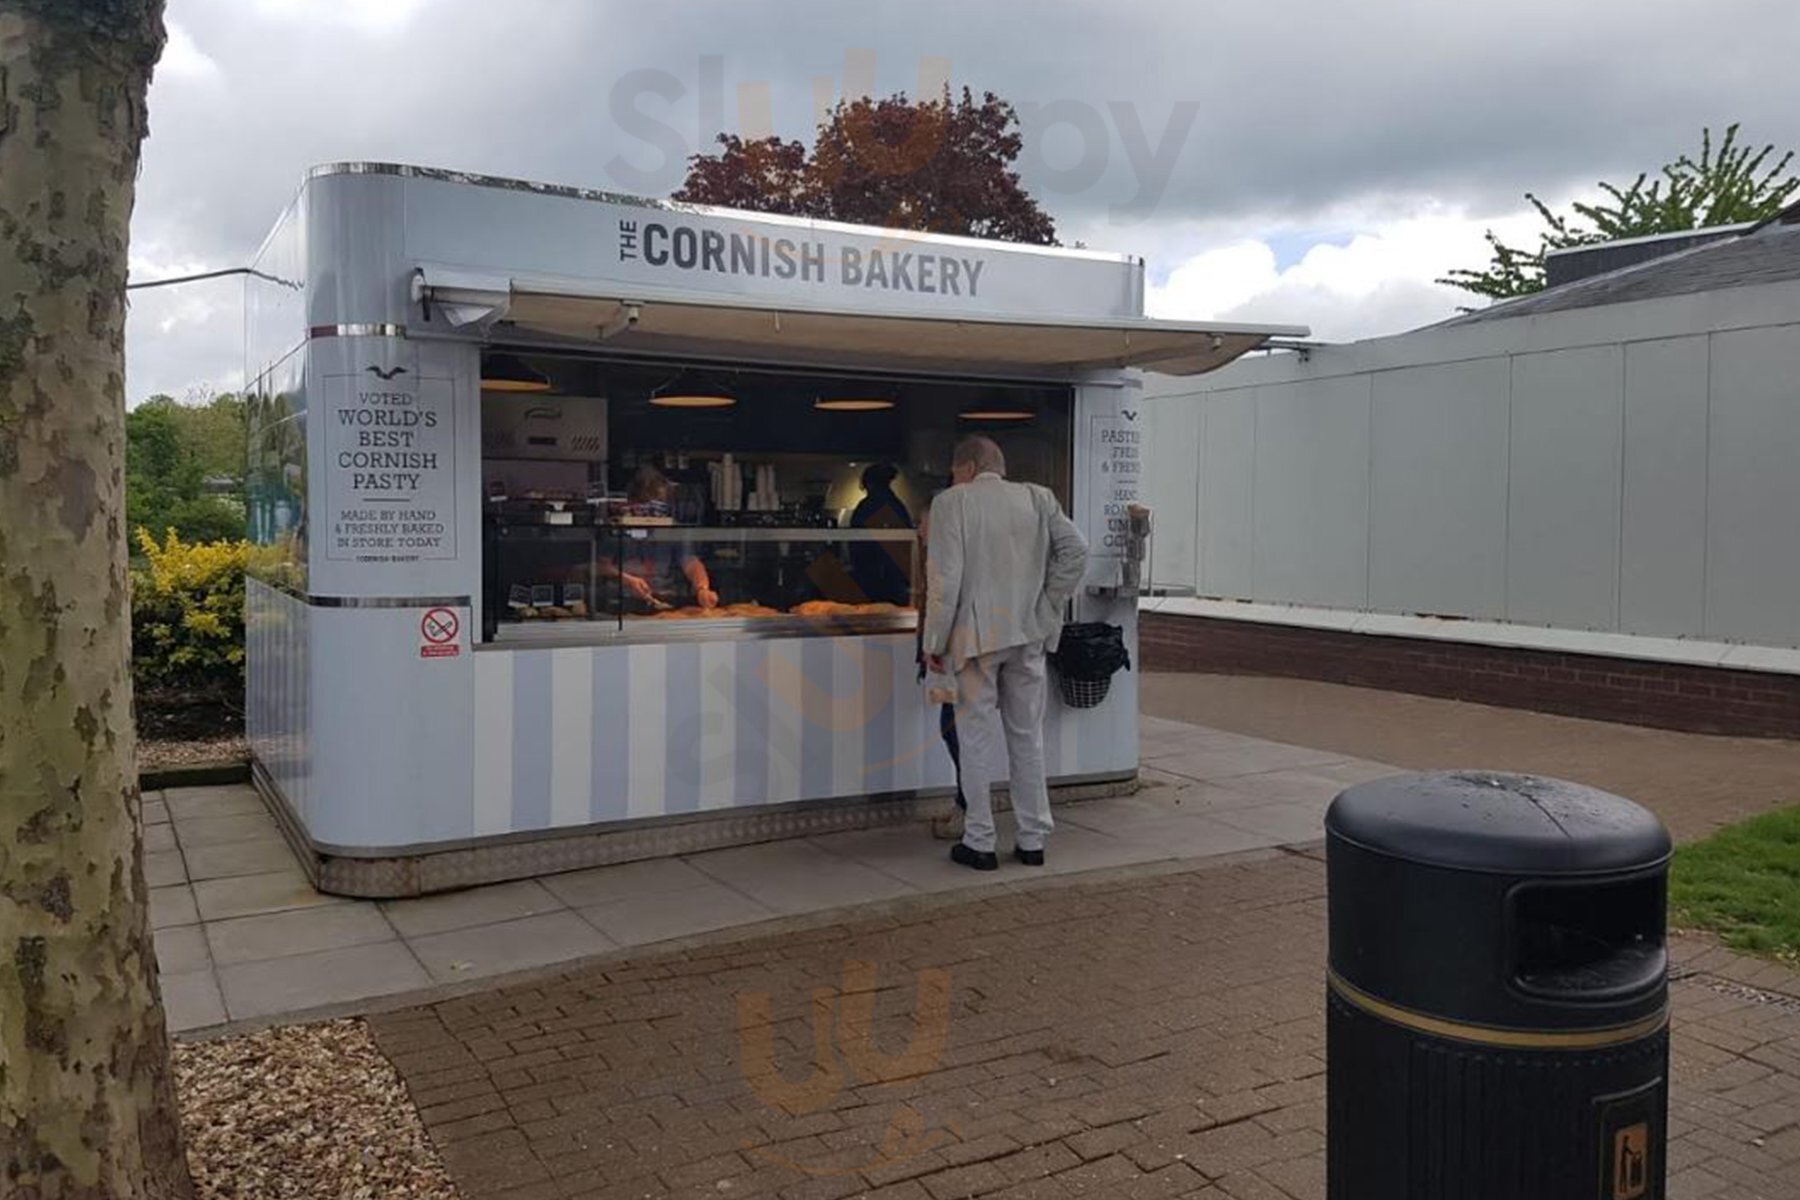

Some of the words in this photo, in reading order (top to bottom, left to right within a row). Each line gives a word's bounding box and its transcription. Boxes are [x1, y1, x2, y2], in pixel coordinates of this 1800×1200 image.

[619, 219, 638, 262] THE
[643, 223, 825, 283] CORNISH
[841, 246, 984, 297] BAKERY
[359, 392, 413, 405] VOTED
[338, 408, 438, 428] WORLD'S
[358, 430, 415, 447] BEST
[338, 451, 438, 469] CORNISH
[352, 473, 421, 490] PASTY
[340, 510, 378, 521] MADE
[380, 510, 396, 521] BY
[399, 510, 436, 521] HAND
[344, 523, 399, 535] FRESHLY
[401, 523, 445, 535] BAKED
[351, 537, 394, 548] STORE
[398, 537, 441, 548] TODAY
